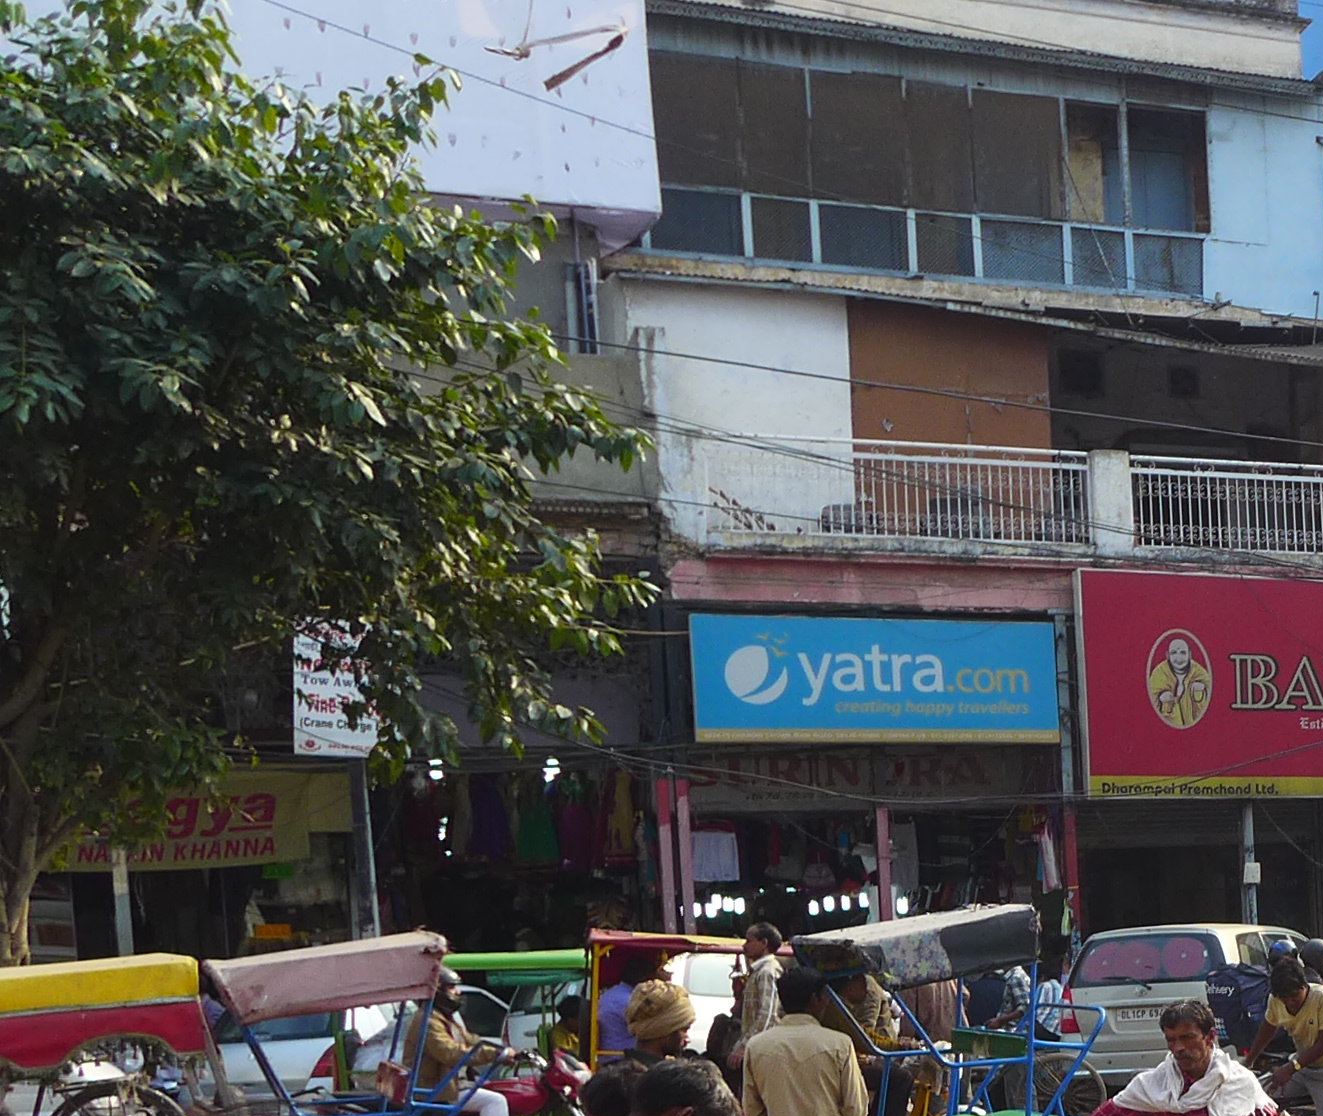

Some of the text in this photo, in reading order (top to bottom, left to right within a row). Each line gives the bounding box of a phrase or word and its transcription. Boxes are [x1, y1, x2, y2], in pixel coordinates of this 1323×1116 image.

[302, 674, 329, 685] Tow
[797, 644, 1030, 706] yatra.com
[835, 701, 1030, 717] creating happy travellers
[1101, 782, 1279, 798] Dharampal Premchand Ltd.
[173, 836, 276, 863] KHANNA
